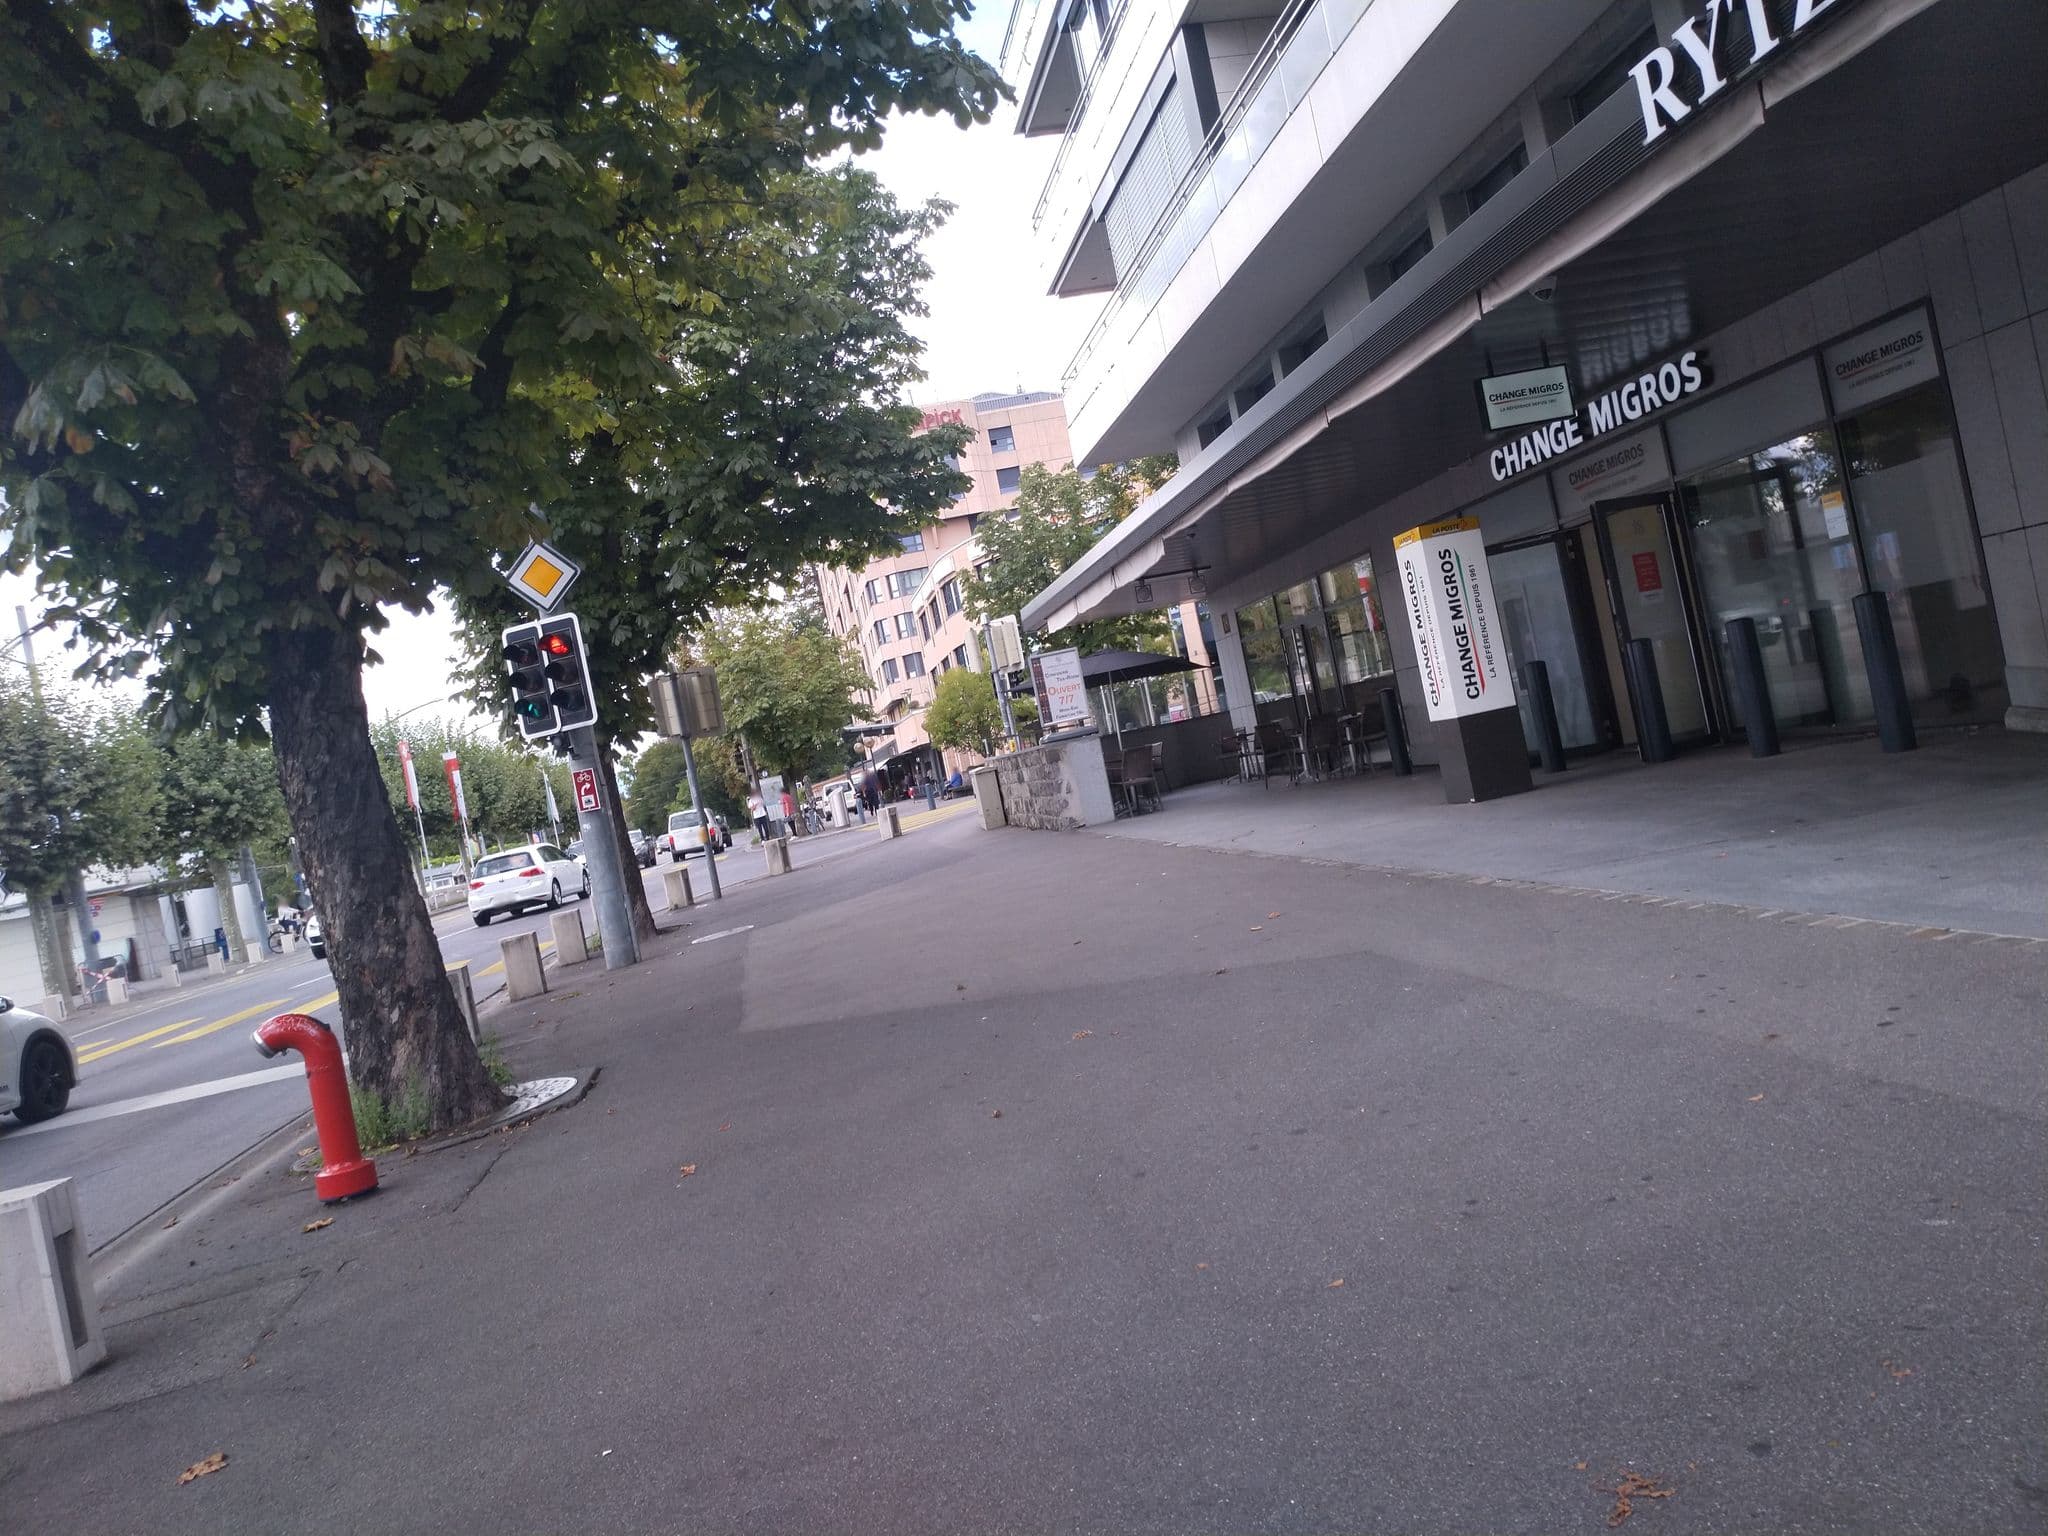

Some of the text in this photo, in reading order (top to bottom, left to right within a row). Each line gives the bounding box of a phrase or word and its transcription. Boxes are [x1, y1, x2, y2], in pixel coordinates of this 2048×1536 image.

[1835, 350, 1879, 376] CHANGE
[1880, 331, 1924, 358] MIGROS
[1489, 382, 1565, 402] CHANGE MIGROS
[1490, 351, 1702, 481] CHANGE MIGROS
[1568, 444, 1645, 486] CHANGE MIGROS
[1468, 564, 1477, 581] 1961
[1471, 583, 1484, 614] DEPUIS
[1404, 560, 1439, 707] CHANGE MIGROS
[1439, 548, 1480, 700] CHANGE MIGROS
[1487, 667, 1497, 678] LA
